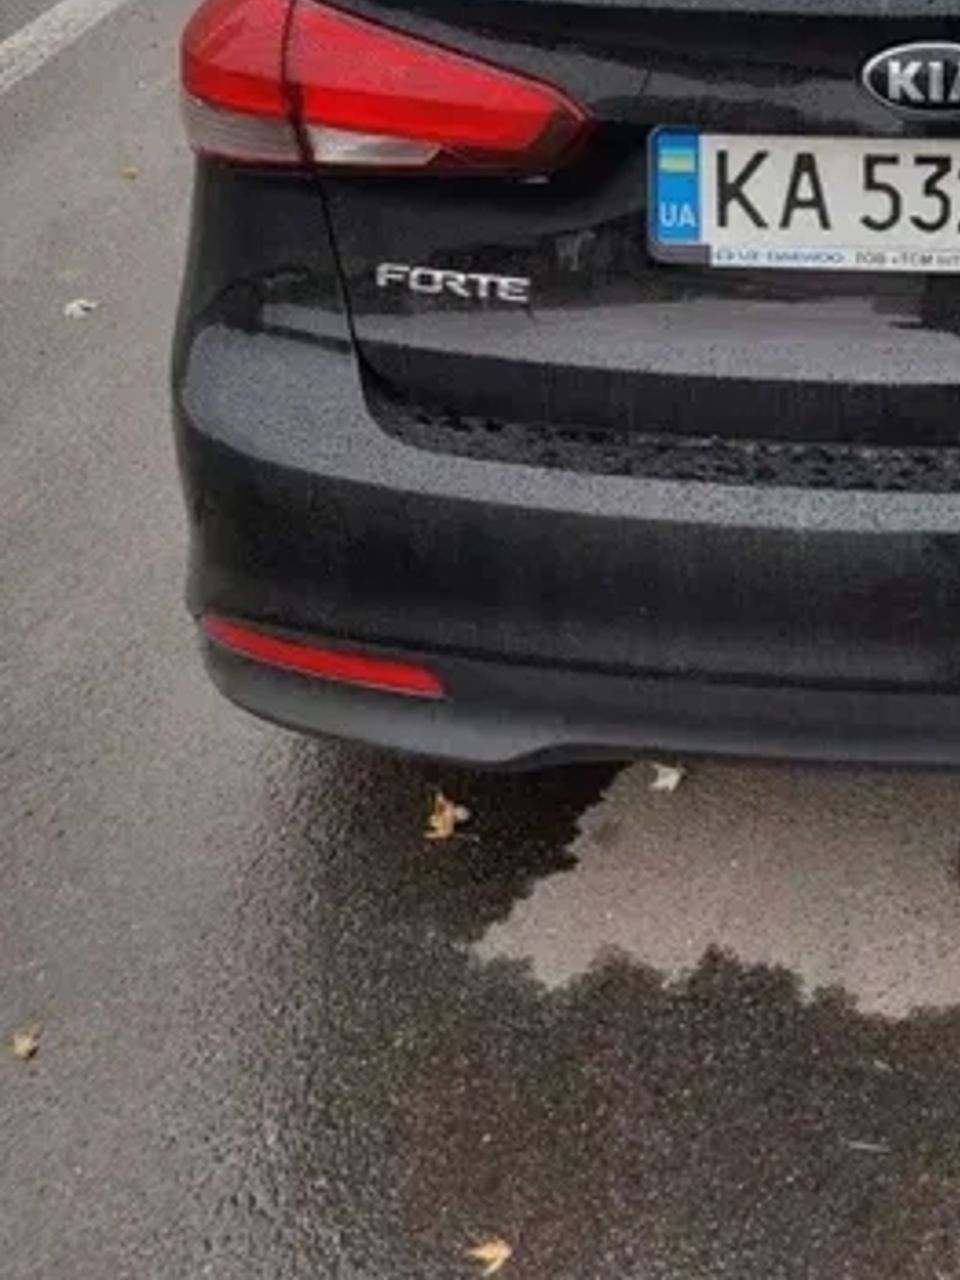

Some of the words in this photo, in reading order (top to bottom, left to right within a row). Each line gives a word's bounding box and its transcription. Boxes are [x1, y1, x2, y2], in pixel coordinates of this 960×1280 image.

[716, 149, 832, 231] KA
[659, 202, 697, 229] UA
[375, 263, 531, 303] FORTE
